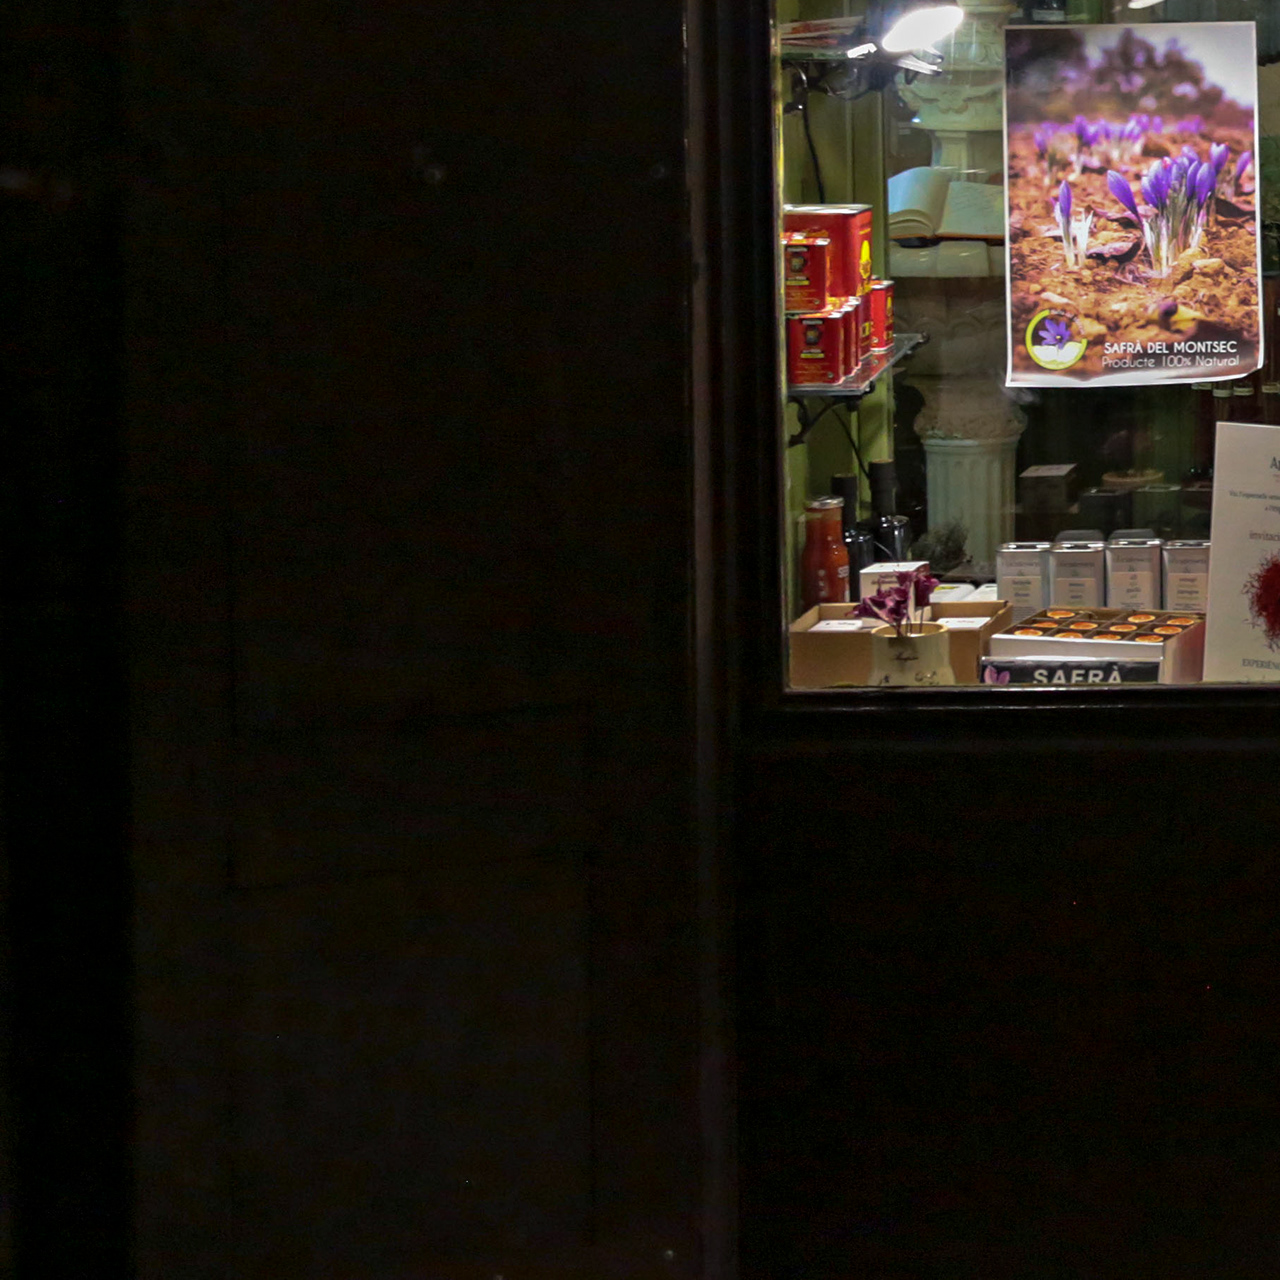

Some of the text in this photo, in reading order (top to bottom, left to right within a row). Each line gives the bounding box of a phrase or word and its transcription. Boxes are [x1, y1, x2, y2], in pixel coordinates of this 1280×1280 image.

[1104, 339, 1238, 355] SAFRÀ DEL MONTSEC
[1102, 355, 1240, 369] Producte 100% Natural
